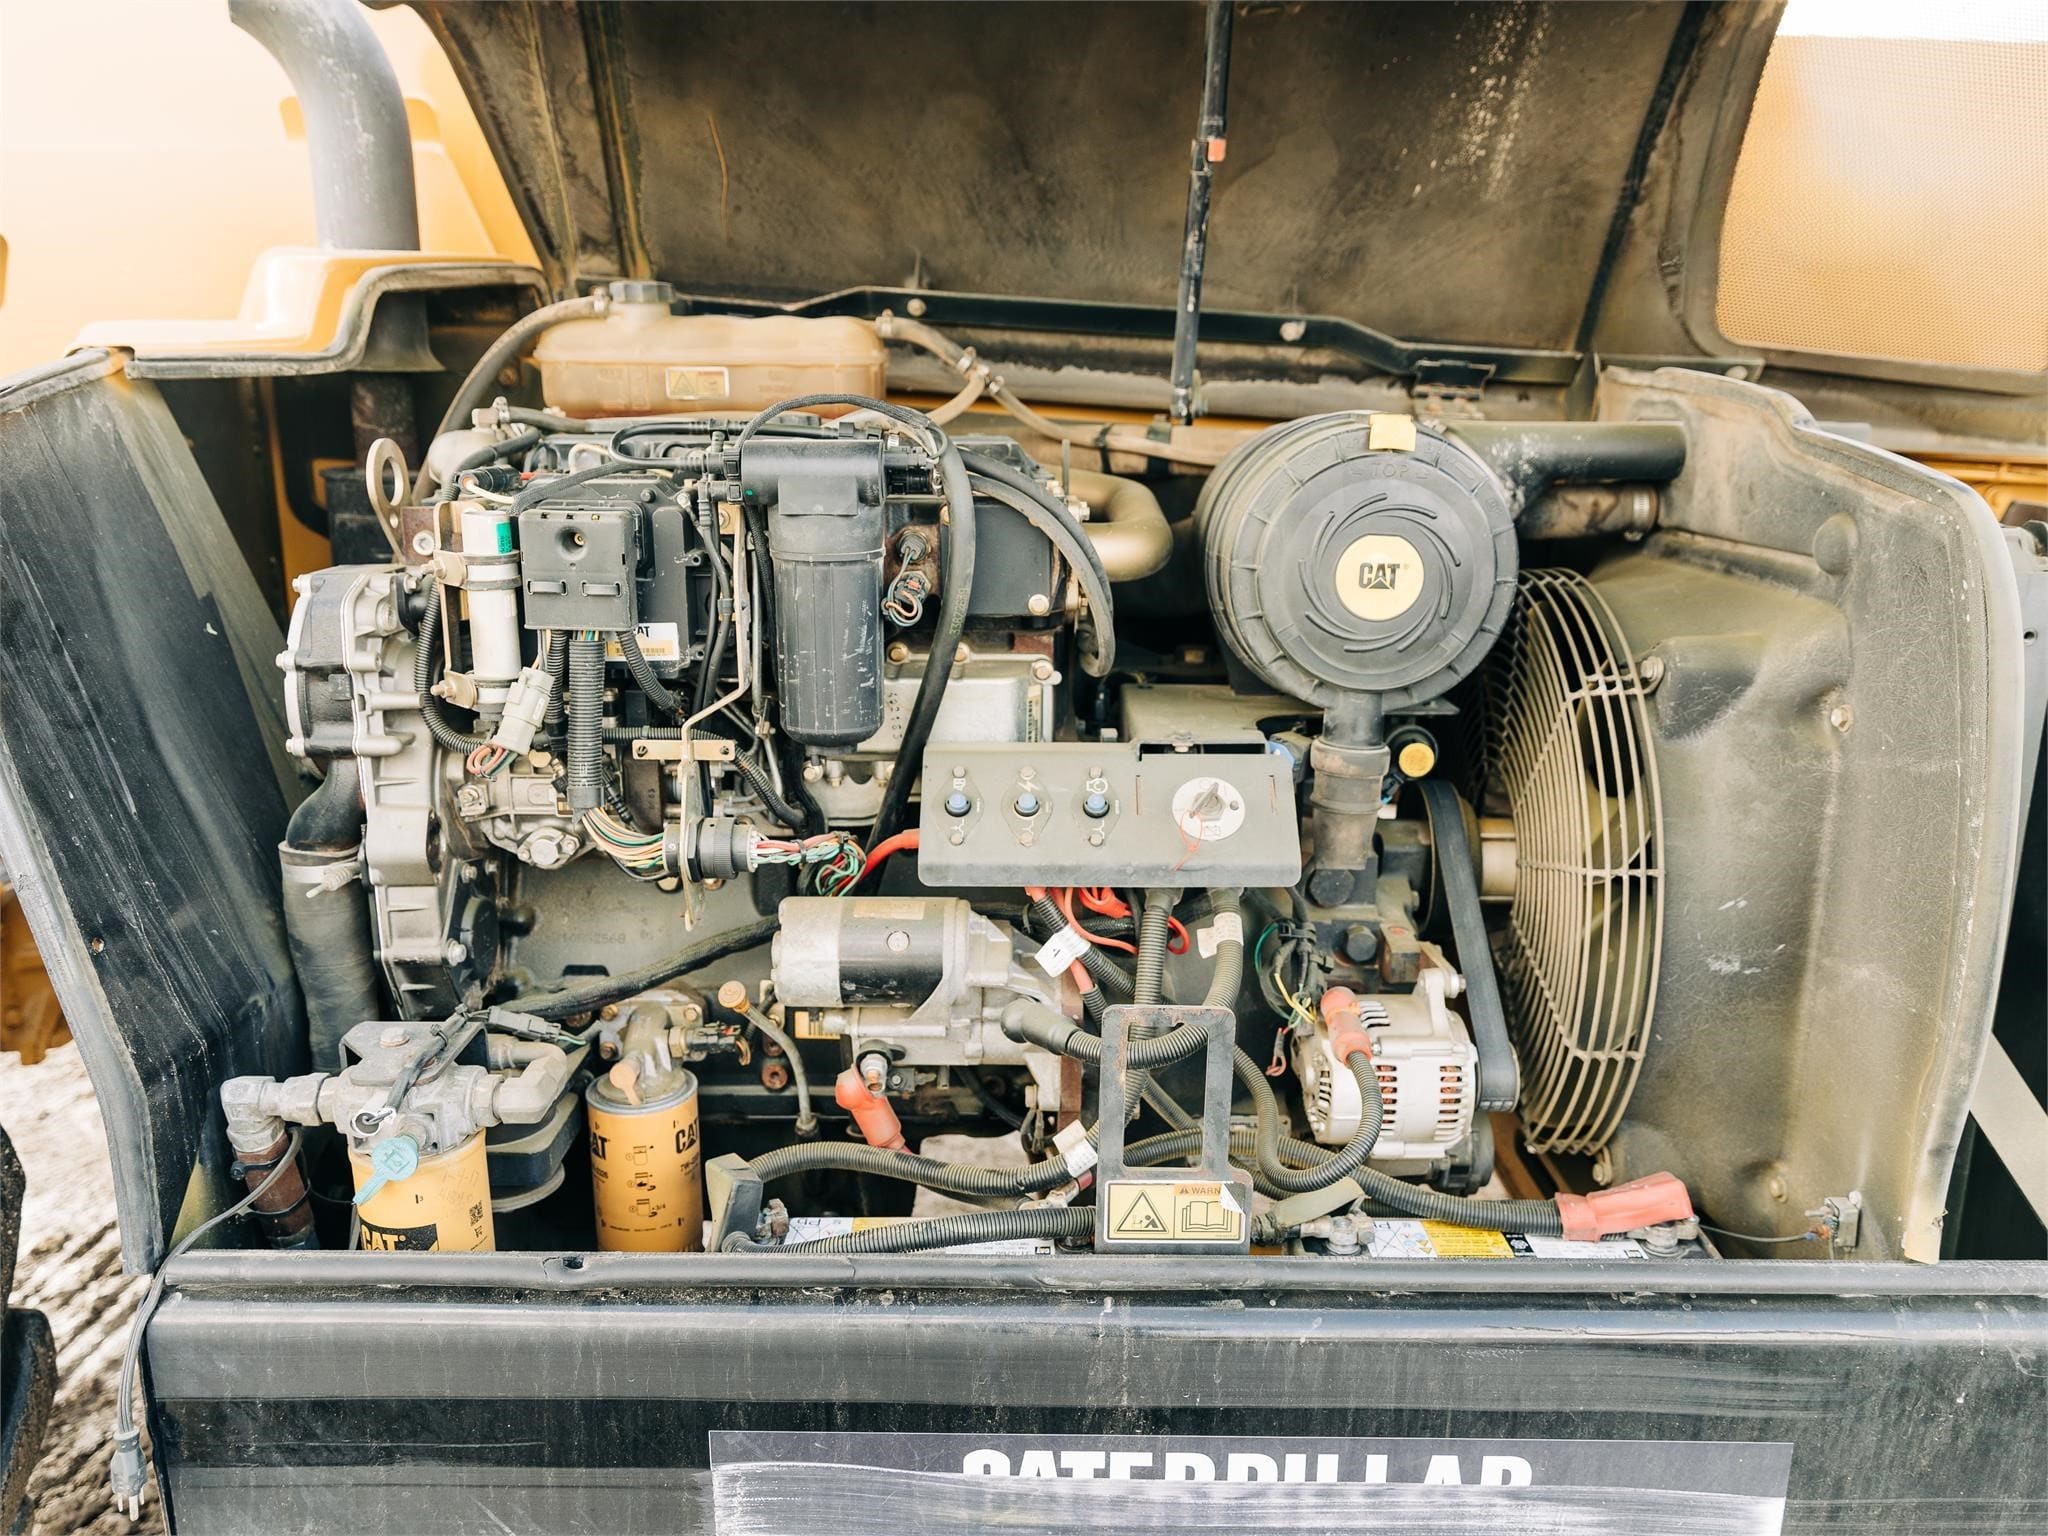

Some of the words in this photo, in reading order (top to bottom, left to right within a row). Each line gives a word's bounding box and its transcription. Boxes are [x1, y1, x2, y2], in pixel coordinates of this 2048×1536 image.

[1371, 462, 1409, 479] TOP
[1358, 562, 1400, 590] CAT
[636, 626, 650, 638] AT
[590, 1131, 608, 1161] AT
[1191, 1187, 1221, 1195] WARN
[361, 1224, 399, 1250] CAT
